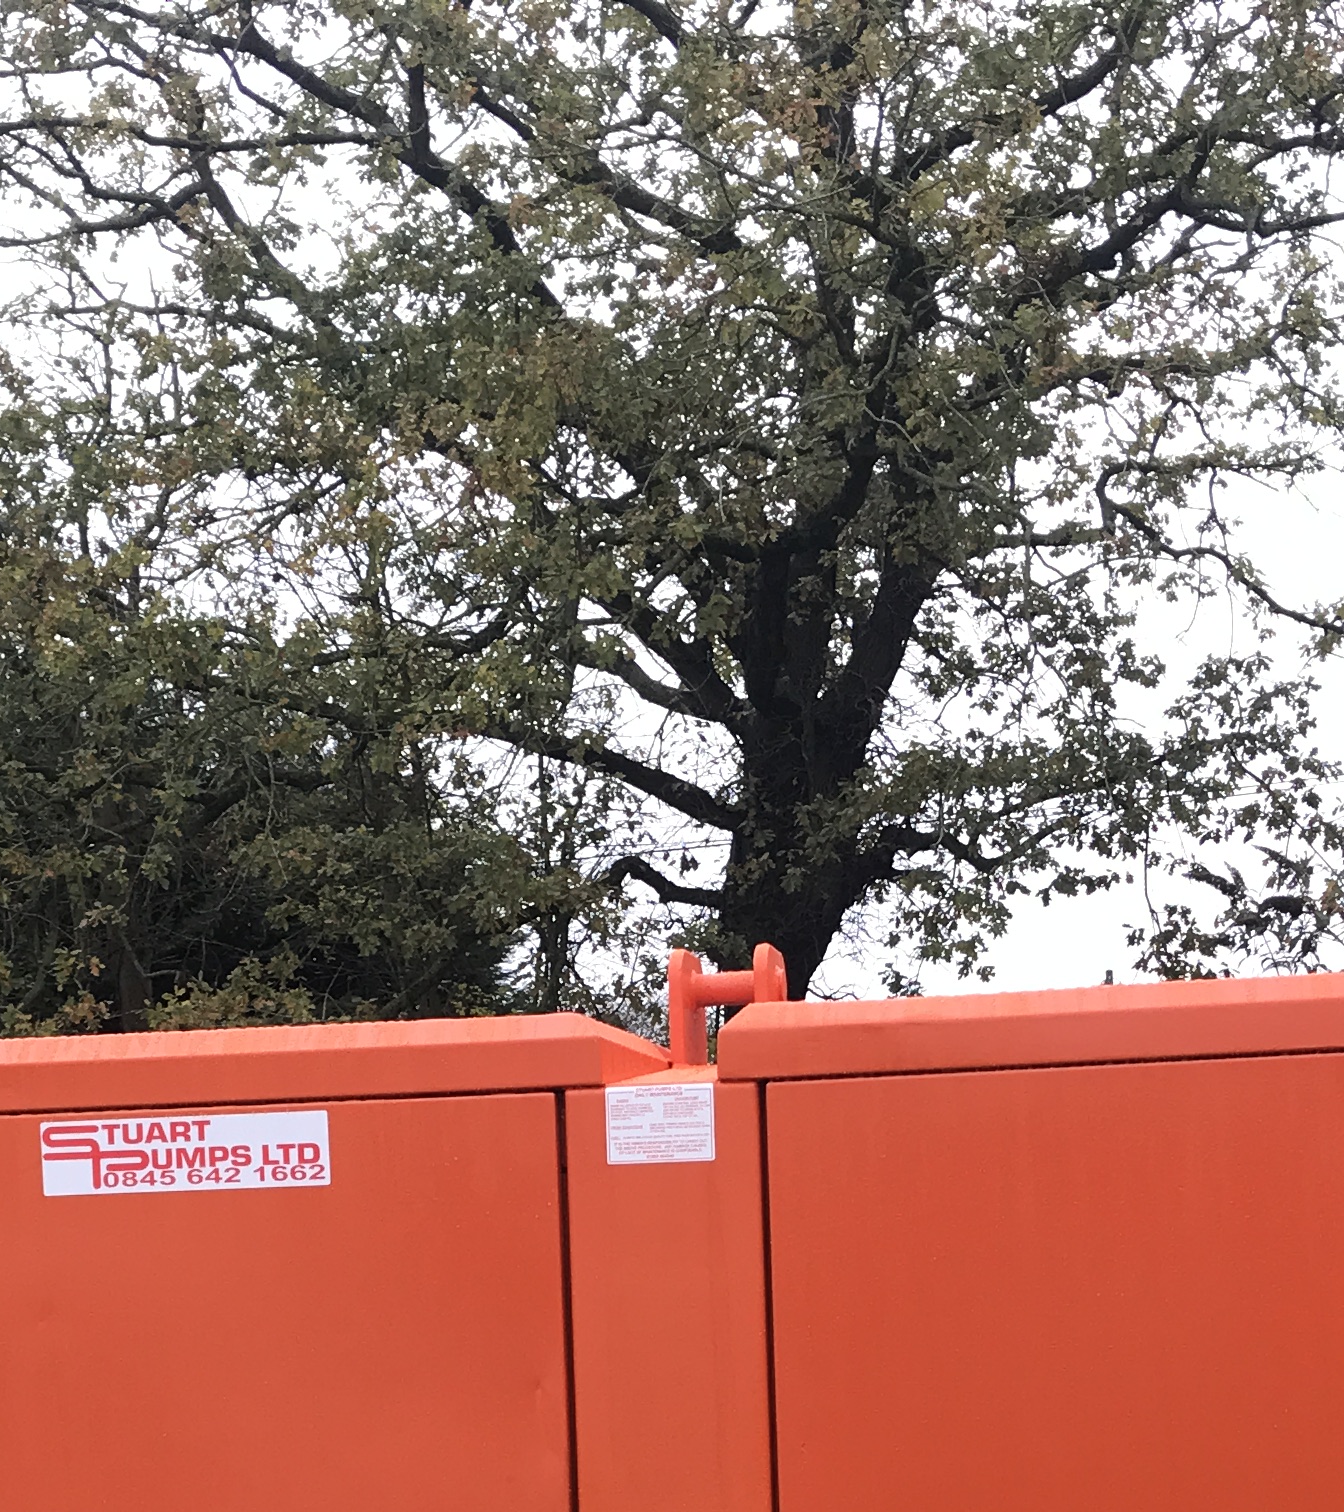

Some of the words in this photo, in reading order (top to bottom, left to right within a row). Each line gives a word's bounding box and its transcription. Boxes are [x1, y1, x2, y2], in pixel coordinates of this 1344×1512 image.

[42, 1119, 212, 1160] STUART
[92, 1144, 253, 1189] PUMPS
[261, 1142, 321, 1166] LTD
[103, 1169, 177, 1189] 0845
[186, 1166, 242, 1185] 642
[253, 1164, 326, 1183] 1662
